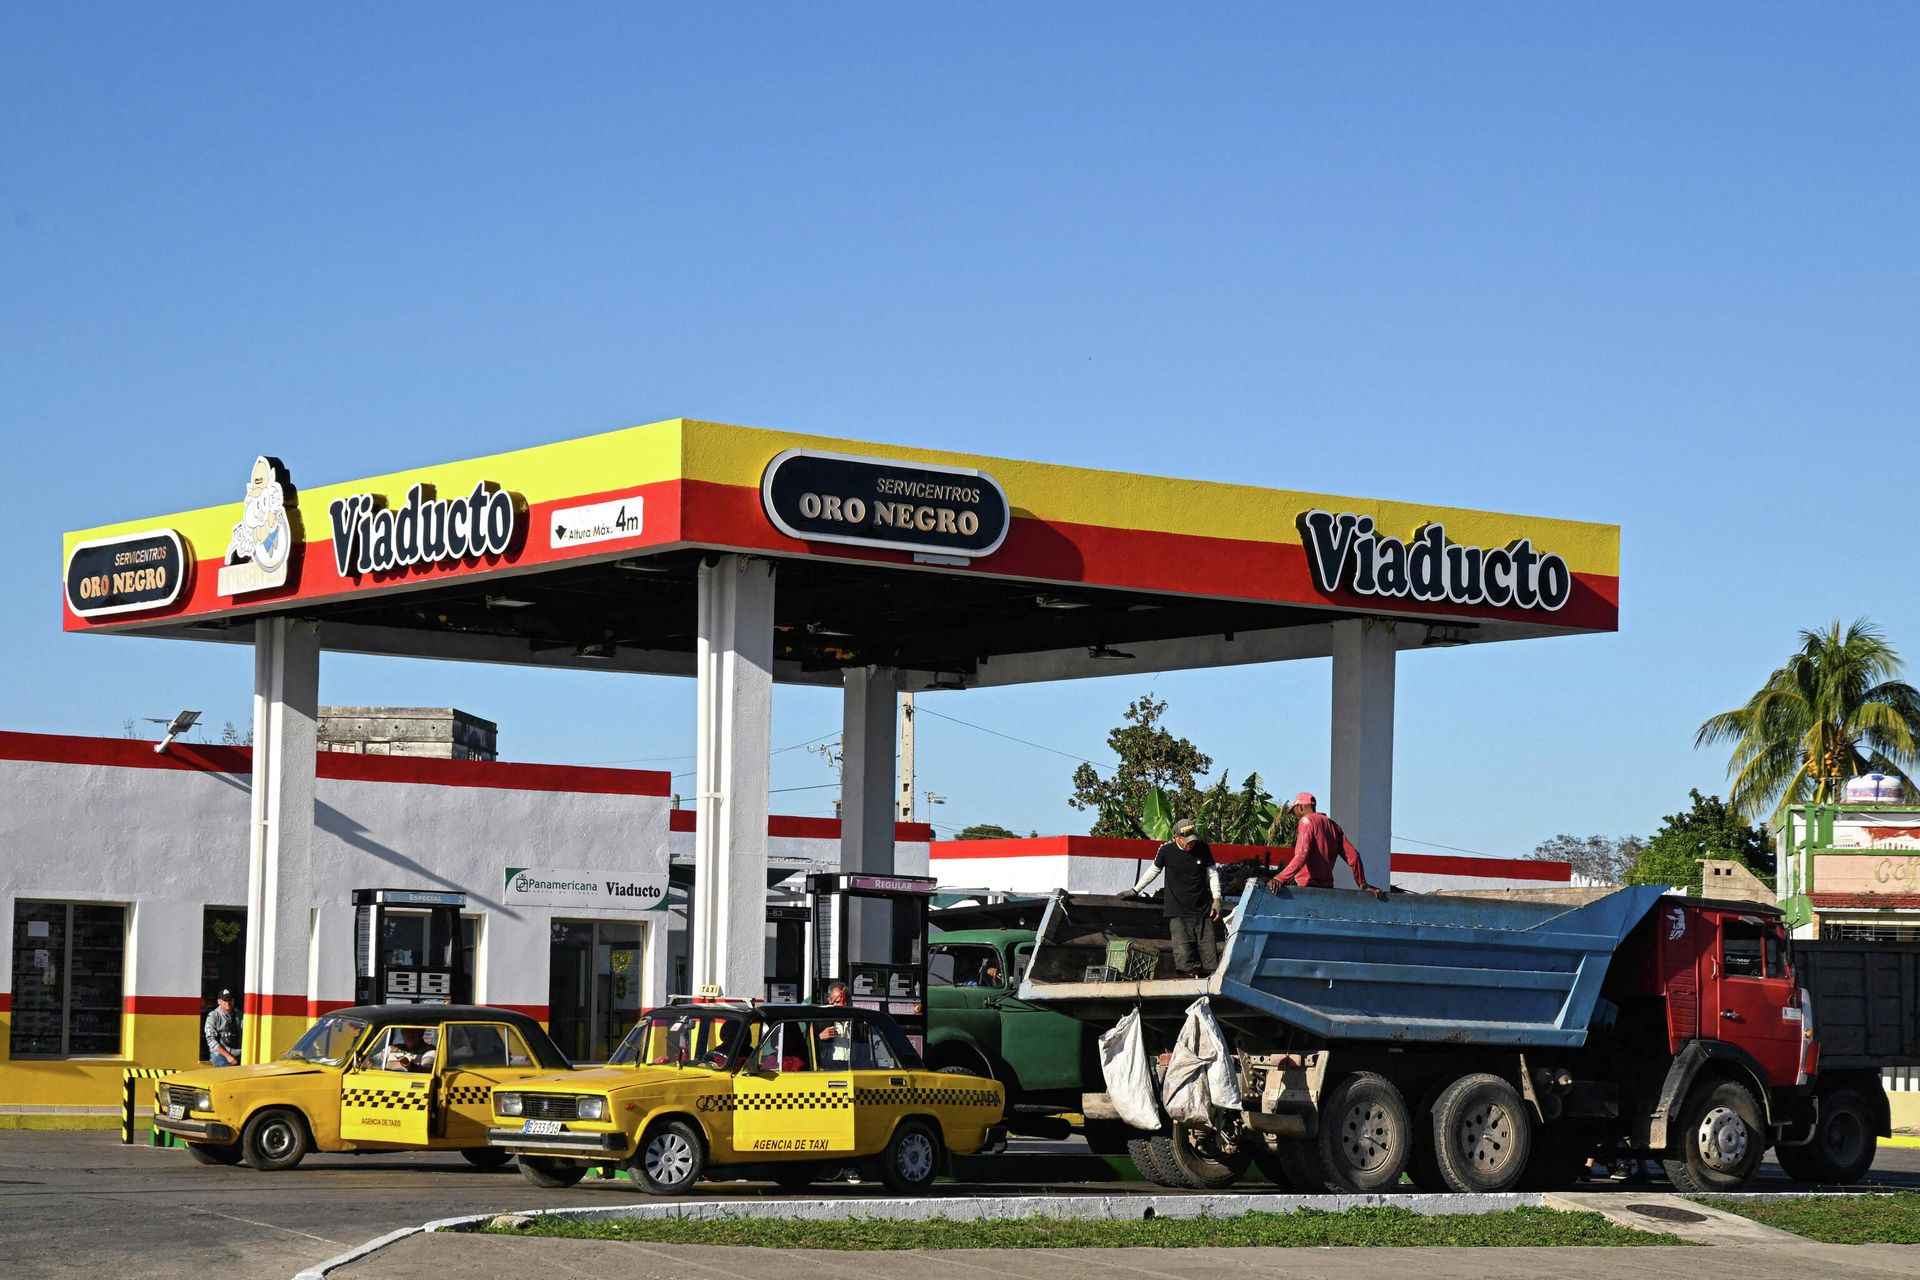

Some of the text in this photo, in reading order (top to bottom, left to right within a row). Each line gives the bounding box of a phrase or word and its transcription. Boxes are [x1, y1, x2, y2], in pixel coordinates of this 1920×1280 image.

[876, 477, 981, 504] SERVICENTROS
[569, 529, 591, 540] Altura
[615, 505, 639, 531] 4m
[799, 492, 979, 536] ORO NEGRO
[330, 480, 514, 577] Viaducto
[114, 545, 167, 566] SERVICENTROS
[1305, 510, 1571, 611] Viaducto
[80, 566, 166, 600] ORO NEGRO
[409, 893, 443, 902] ESPECIAL
[528, 878, 661, 898] Panamericana Viaducto
[875, 879, 912, 890] REGULAR
[753, 1139, 829, 1150] AGENCIA DE TAXI
